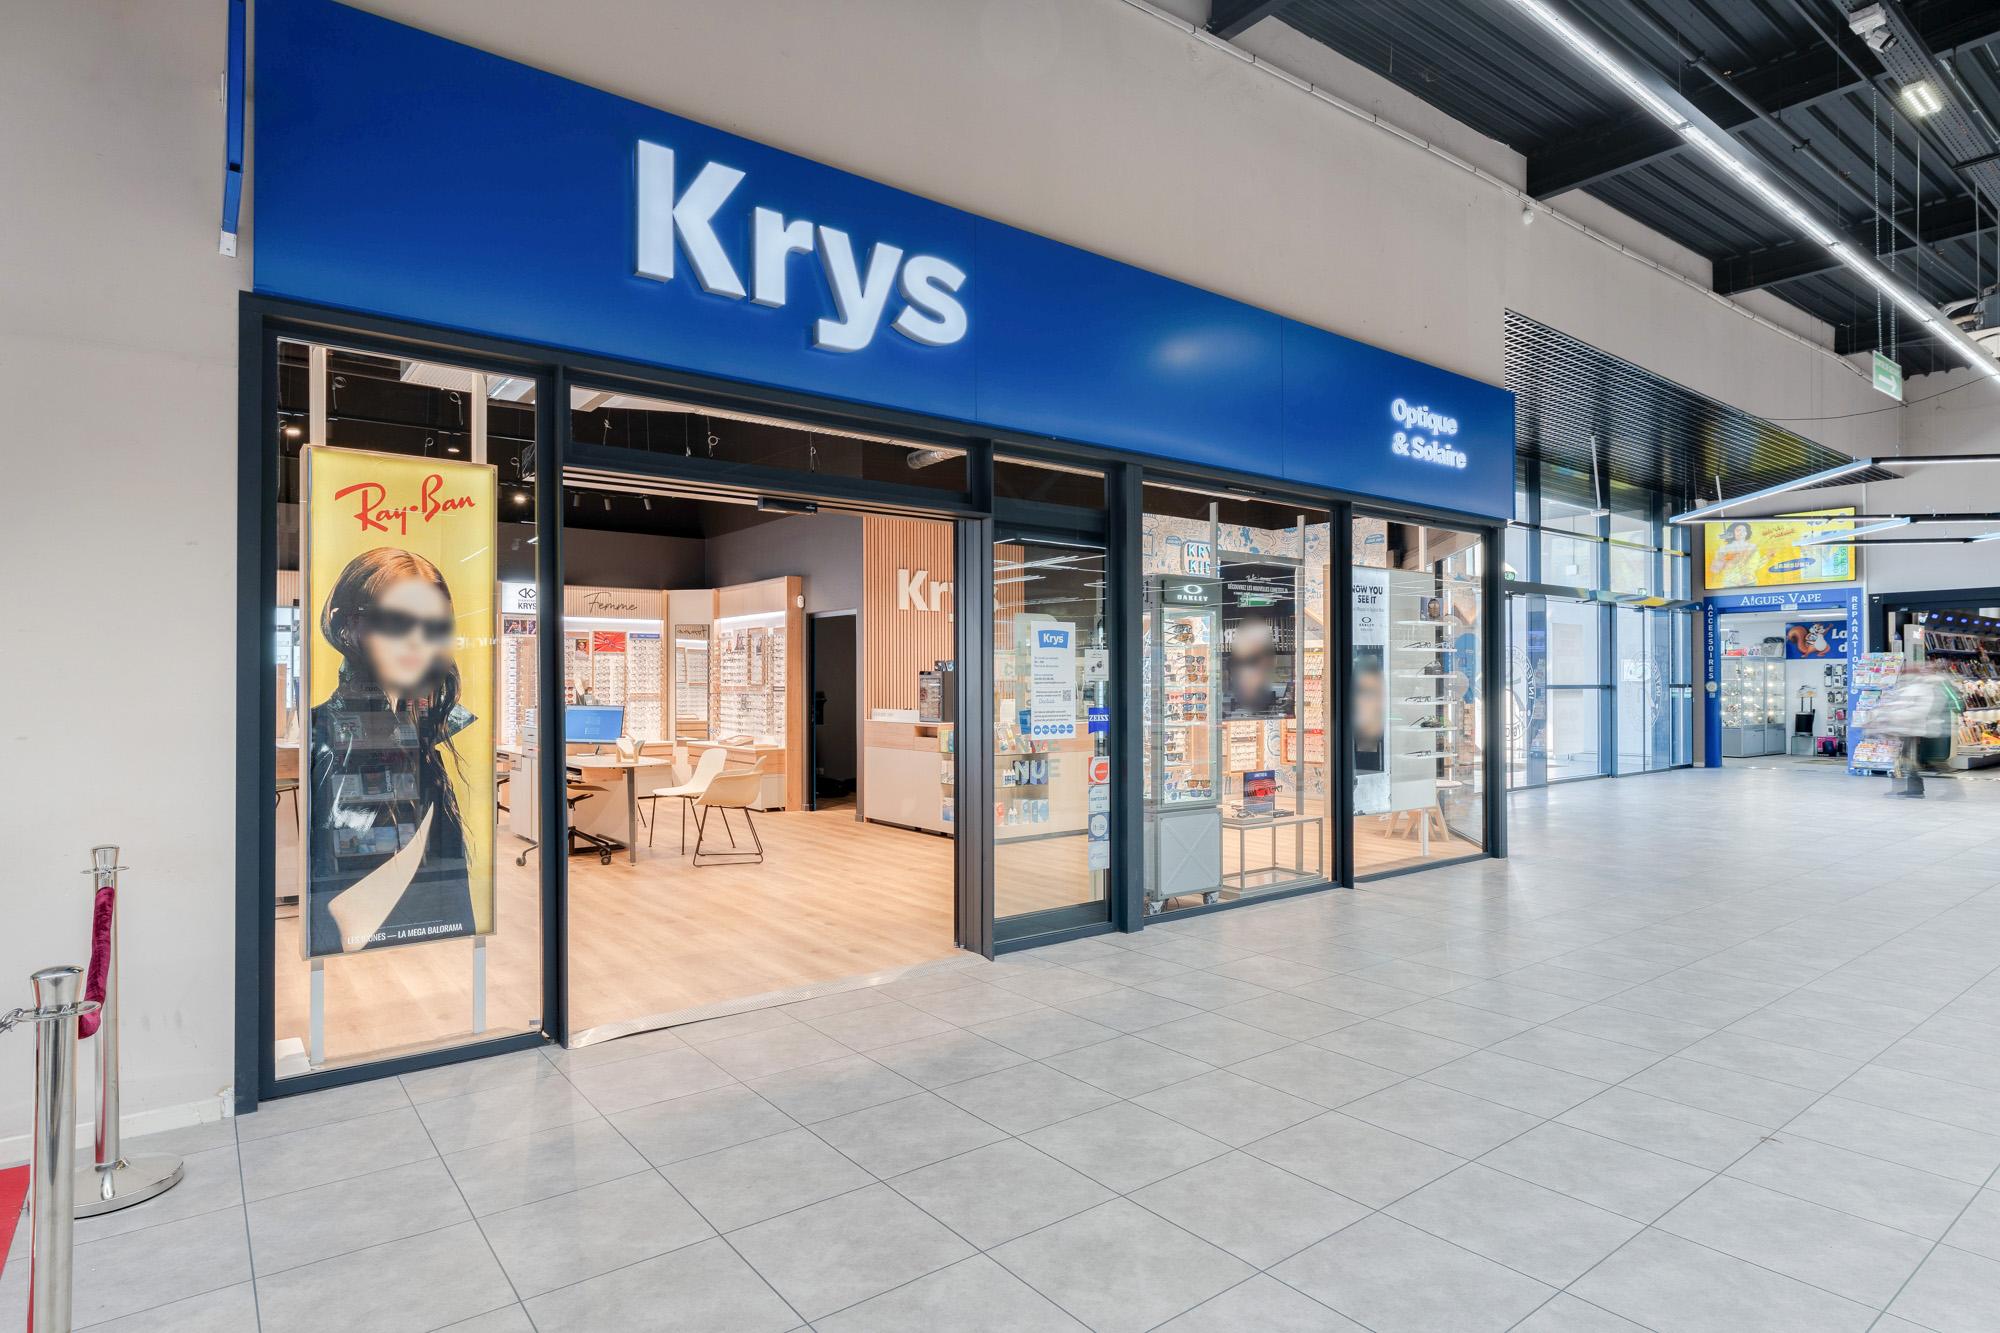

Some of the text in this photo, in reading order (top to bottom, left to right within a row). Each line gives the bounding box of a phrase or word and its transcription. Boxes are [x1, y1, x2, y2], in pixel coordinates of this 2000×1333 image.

[634, 139, 968, 350] Krys
[1391, 398, 1458, 435] Optique
[1392, 432, 1467, 468] & Solaire
[897, 568, 954, 612] Kr
[1177, 594, 1209, 602] OAKLEY
[1369, 585, 1383, 595] YOU
[1788, 592, 1822, 604] VAPE
[583, 591, 637, 613] Femme
[1357, 595, 1377, 604] SEE IT
[1043, 633, 1064, 646] Krys
[1851, 596, 1859, 672] REPARATION
[1088, 714, 1110, 722] ZEISS
[397, 929, 407, 939] LA
[407, 926, 427, 937] MEGA
[427, 923, 464, 935] BALORAMA
